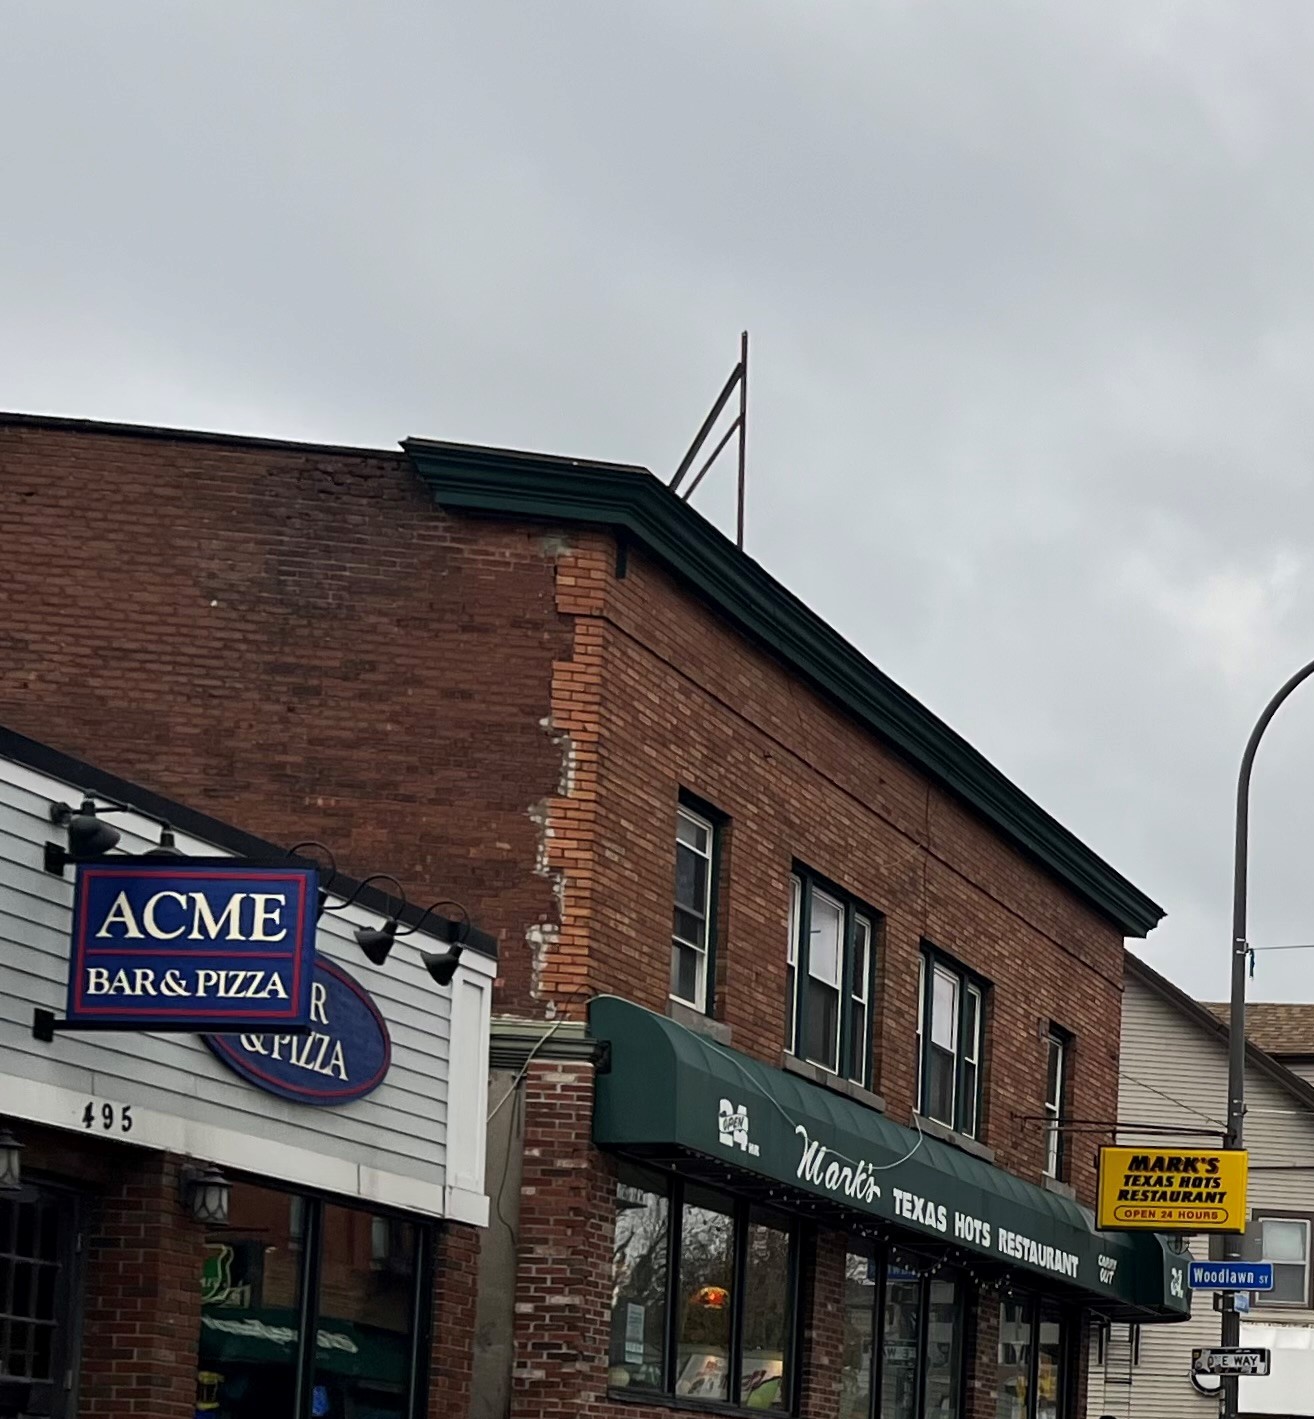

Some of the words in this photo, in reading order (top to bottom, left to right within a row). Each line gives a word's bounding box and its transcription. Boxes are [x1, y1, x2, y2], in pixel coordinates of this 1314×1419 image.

[95, 890, 287, 942] ACME
[86, 967, 158, 996] BAR
[159, 969, 191, 997] &
[195, 969, 289, 999] PIZZA
[271, 1033, 350, 1082] PIZZA
[82, 1101, 133, 1132] 495
[722, 1116, 745, 1129] OPEN
[1127, 1155, 1220, 1174] MARK'S
[1123, 1174, 1174, 1188] TEXAS
[1178, 1175, 1222, 1189] HOTS
[795, 1125, 881, 1203] Mark's
[893, 1187, 947, 1233] TEXAS
[954, 1211, 991, 1248] HOTS
[998, 1228, 1079, 1278] RESTAURANT
[1117, 1189, 1227, 1204] RESTAURANT
[1124, 1208, 1155, 1219] OPEN
[1160, 1209, 1173, 1219] 24
[1178, 1209, 1219, 1220] HOURS
[1193, 1267, 1255, 1284] Woodlawn
[1258, 1275, 1269, 1284] ST
[1207, 1355, 1229, 1368] OE
[1234, 1355, 1258, 1366] WAY
